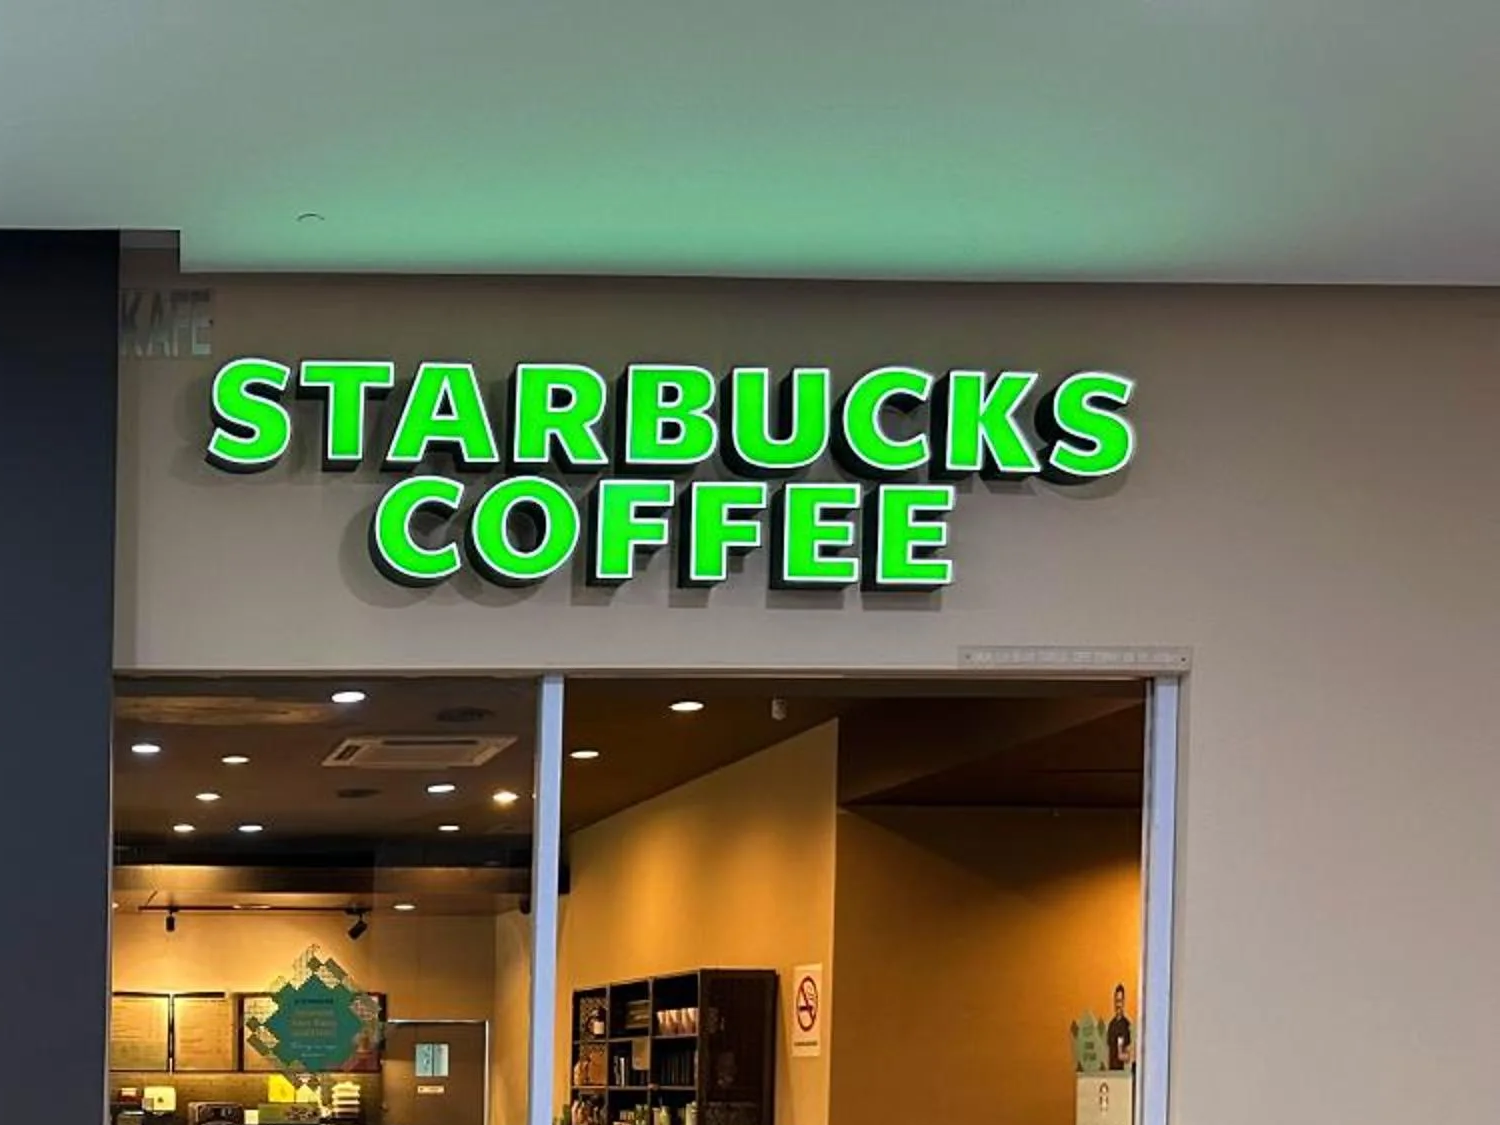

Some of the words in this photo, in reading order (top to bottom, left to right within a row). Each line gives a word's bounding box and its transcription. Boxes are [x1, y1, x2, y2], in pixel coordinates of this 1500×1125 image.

[119, 287, 212, 357] KAFE
[208, 358, 1134, 479] STARBUCKS
[373, 475, 954, 585] COFFEE
